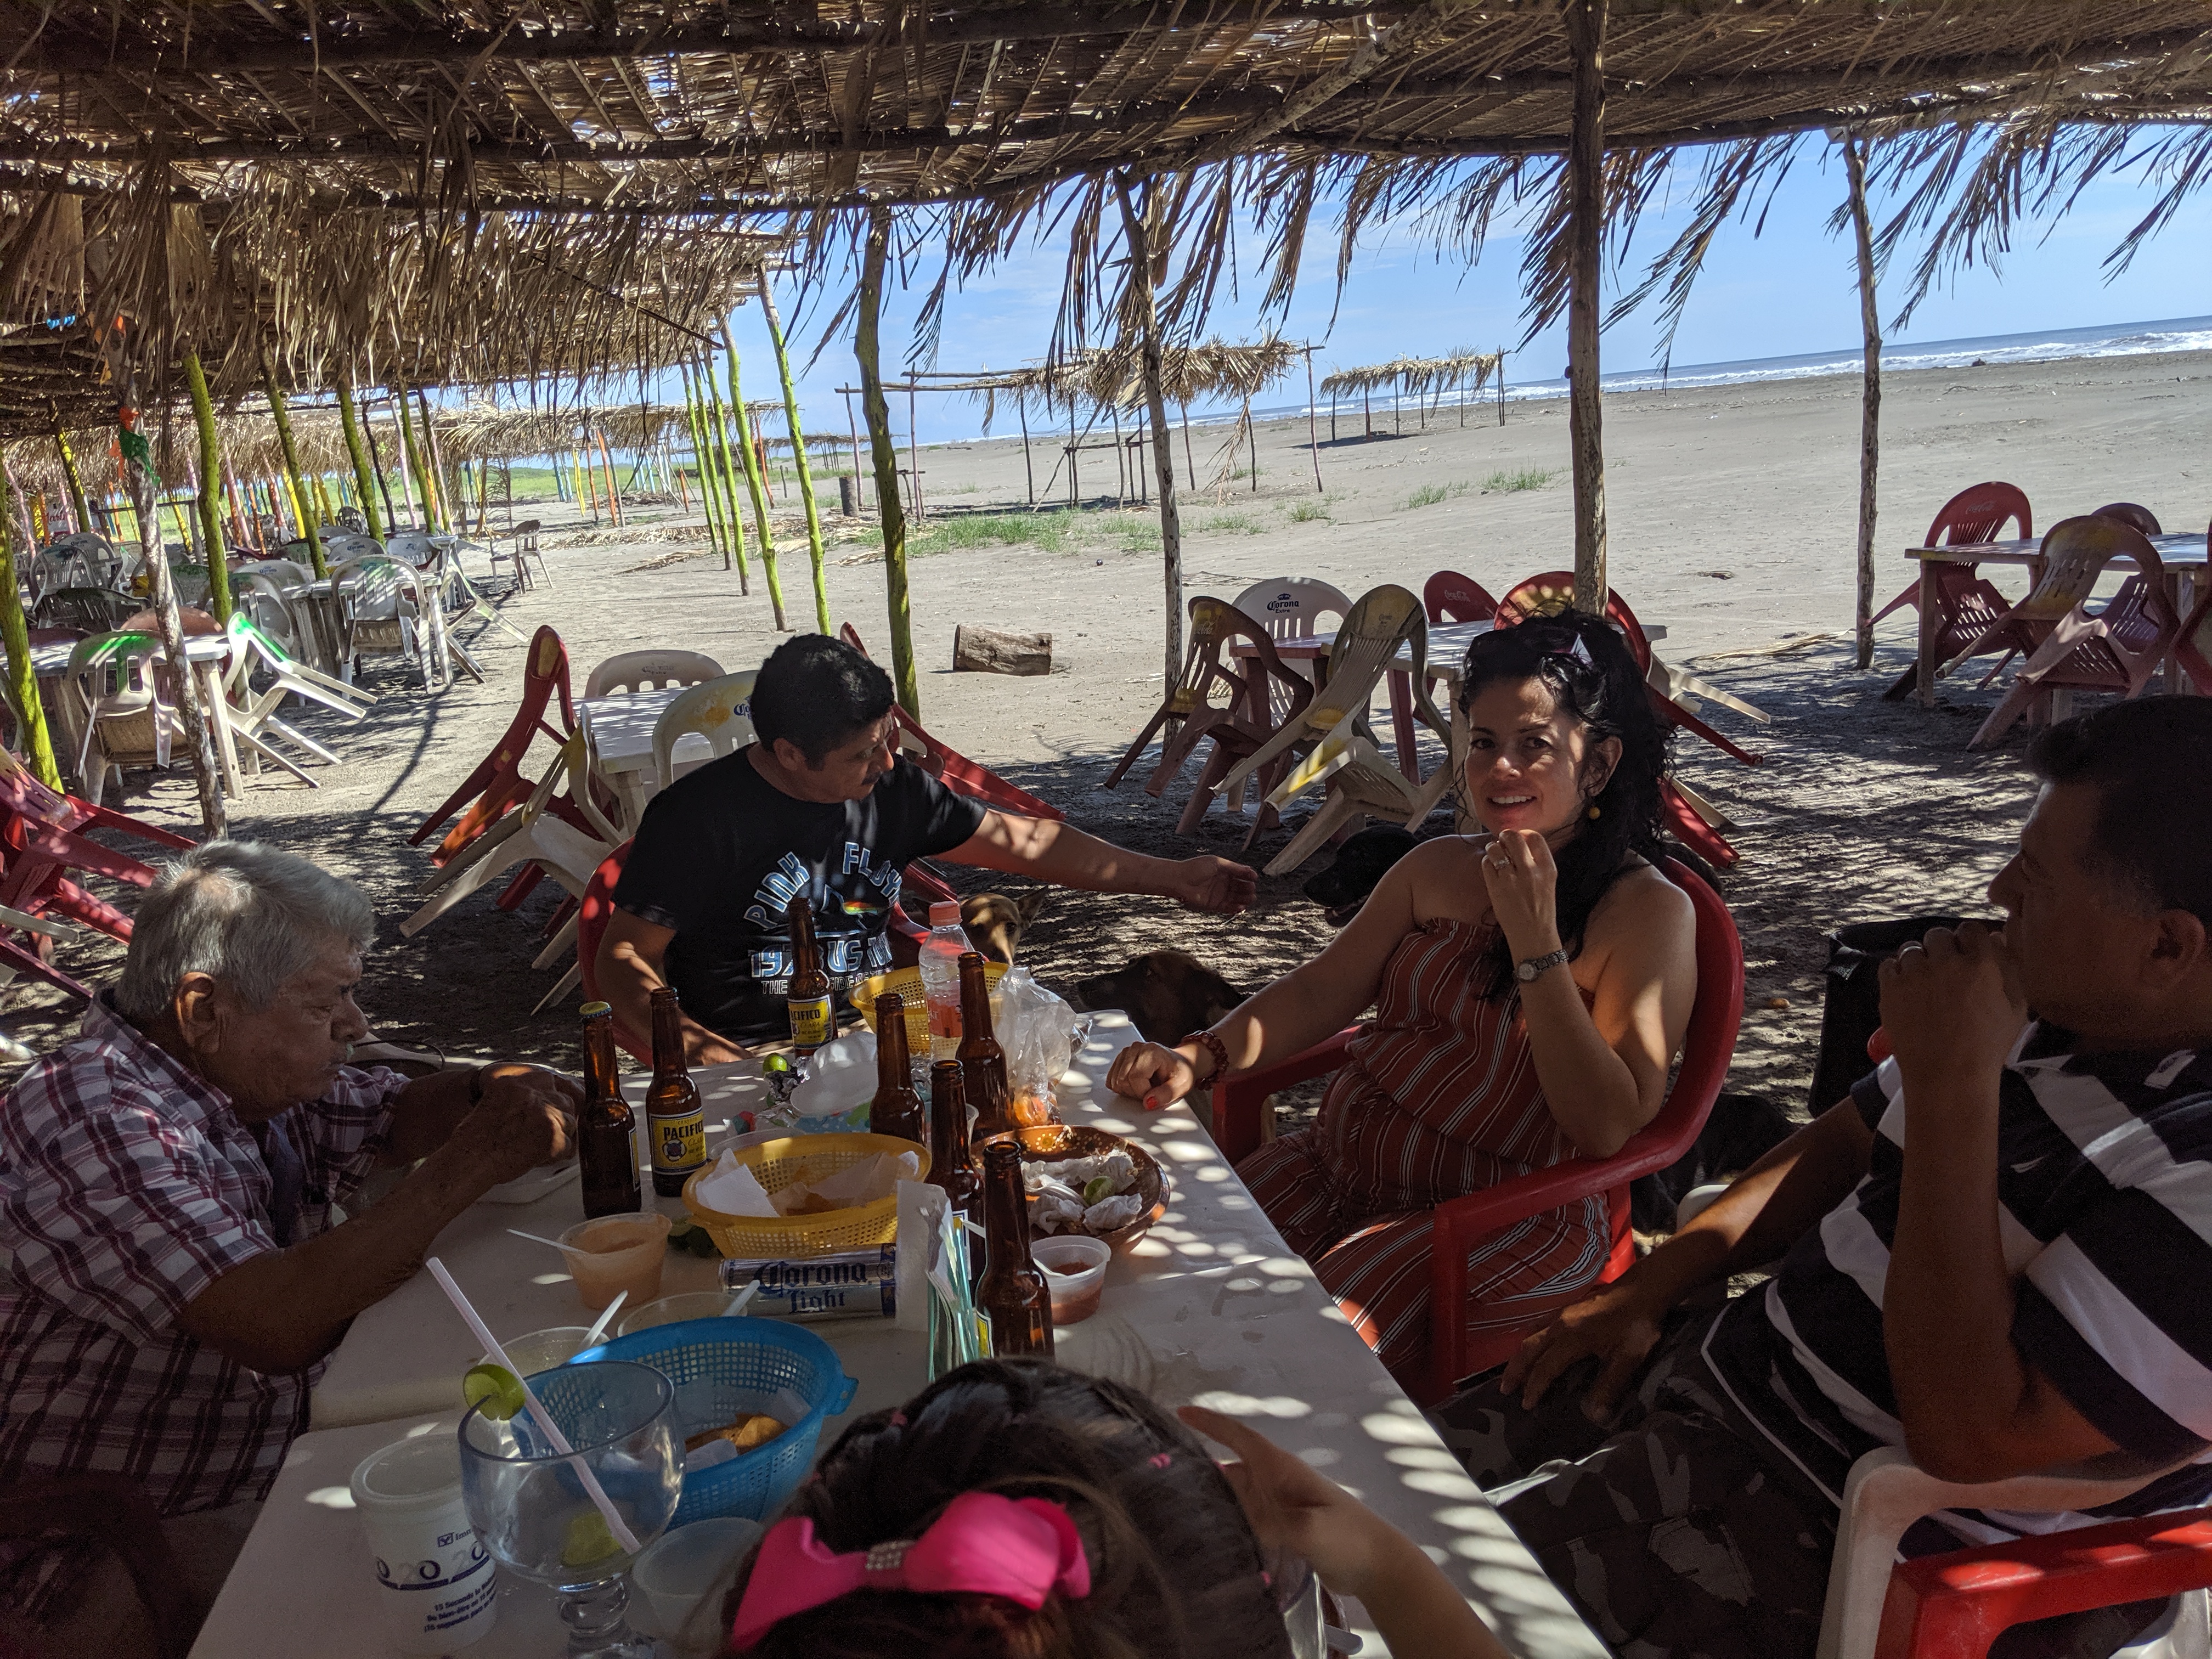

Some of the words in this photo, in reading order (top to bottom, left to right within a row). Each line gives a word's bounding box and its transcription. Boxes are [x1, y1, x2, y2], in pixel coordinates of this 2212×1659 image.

[1267, 600, 1299, 611] Corona
[743, 851, 810, 931] PINK
[827, 939, 864, 973] US
[761, 980, 788, 995] THE
[753, 1261, 868, 1297] Corona
[789, 1289, 845, 1314] Light
